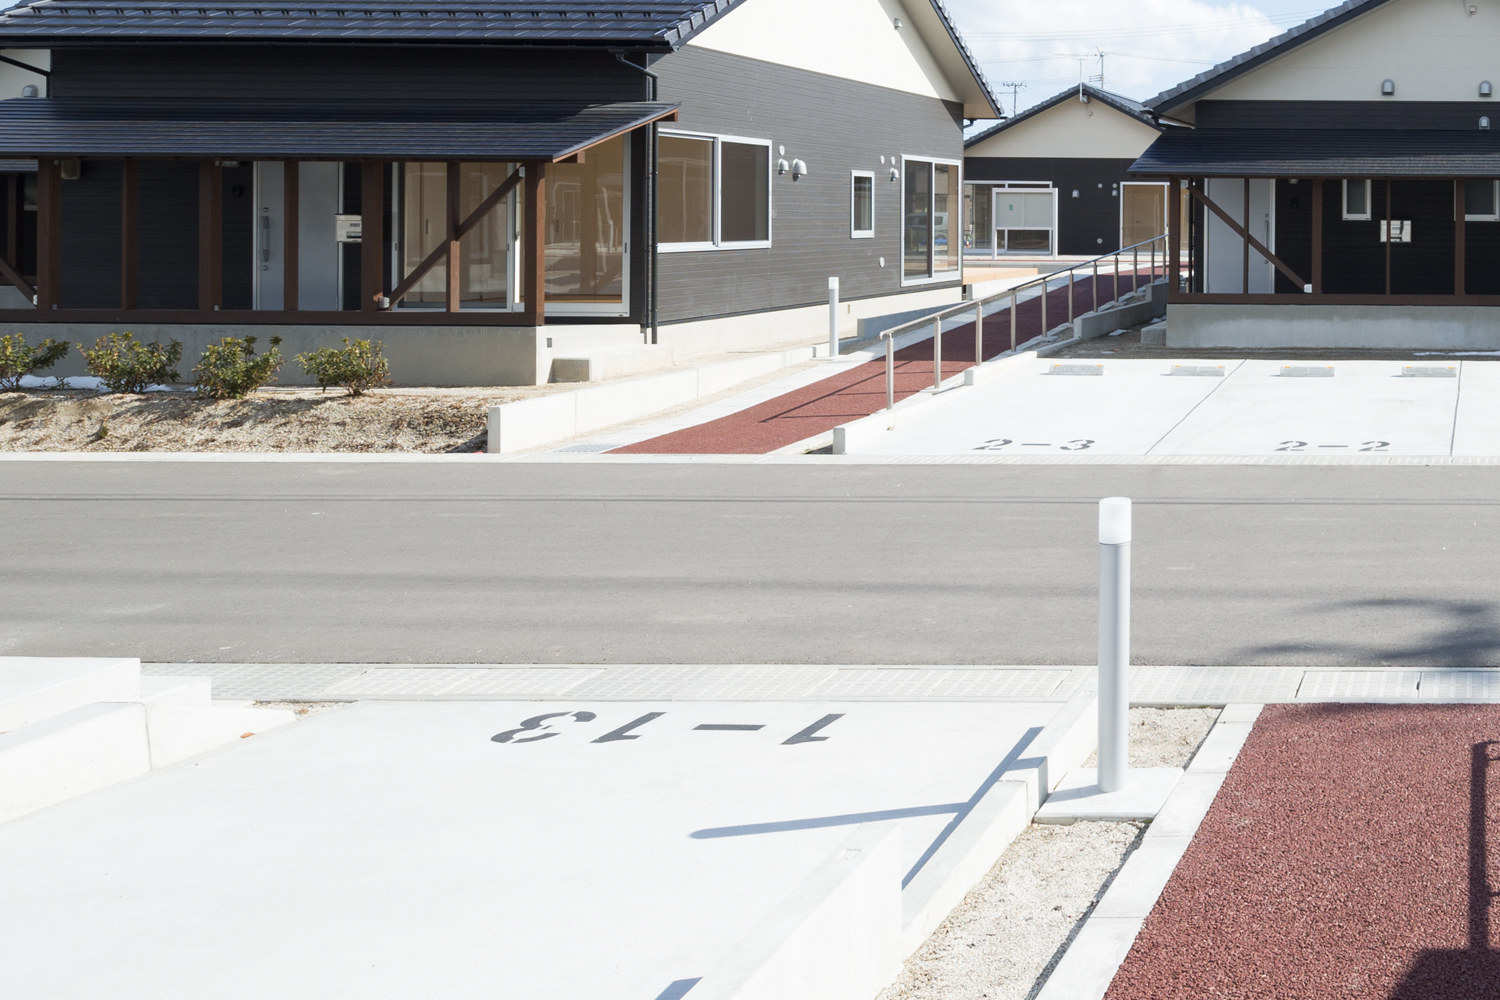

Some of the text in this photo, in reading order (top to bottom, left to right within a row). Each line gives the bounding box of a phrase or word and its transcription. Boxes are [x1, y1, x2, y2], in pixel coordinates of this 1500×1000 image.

[971, 438, 1096, 451] 2-3
[1273, 440, 1391, 452] 2-2
[490, 710, 846, 746] 1-13
